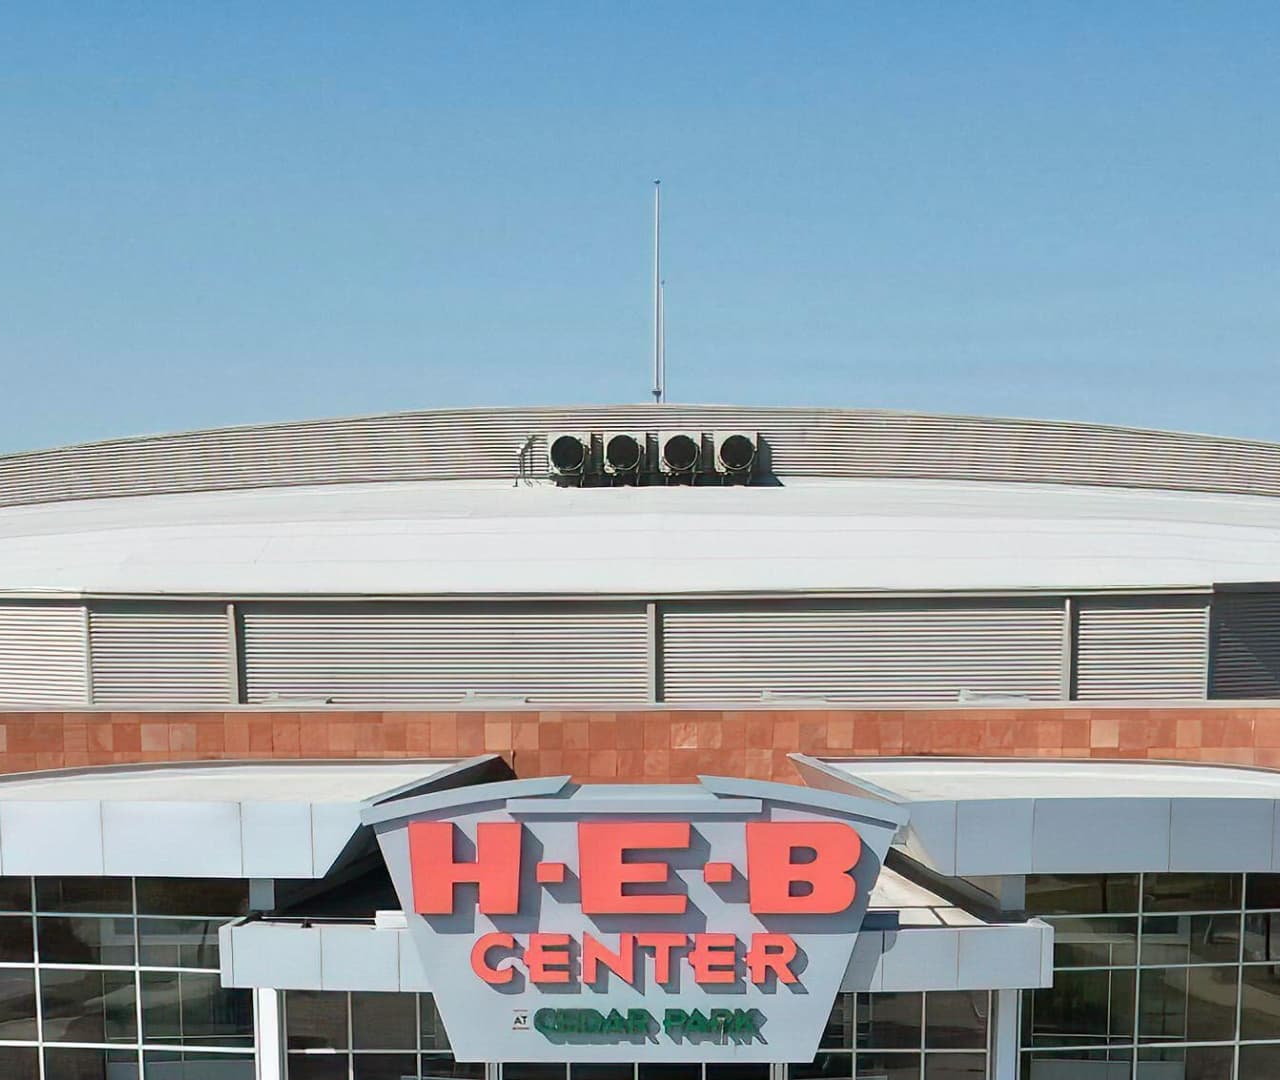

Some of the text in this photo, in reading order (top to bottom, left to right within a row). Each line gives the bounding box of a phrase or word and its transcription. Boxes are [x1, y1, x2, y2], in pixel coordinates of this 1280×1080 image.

[470, 931, 799, 984] CENTER
[514, 1008, 756, 1034] AT CEDAR PARK
